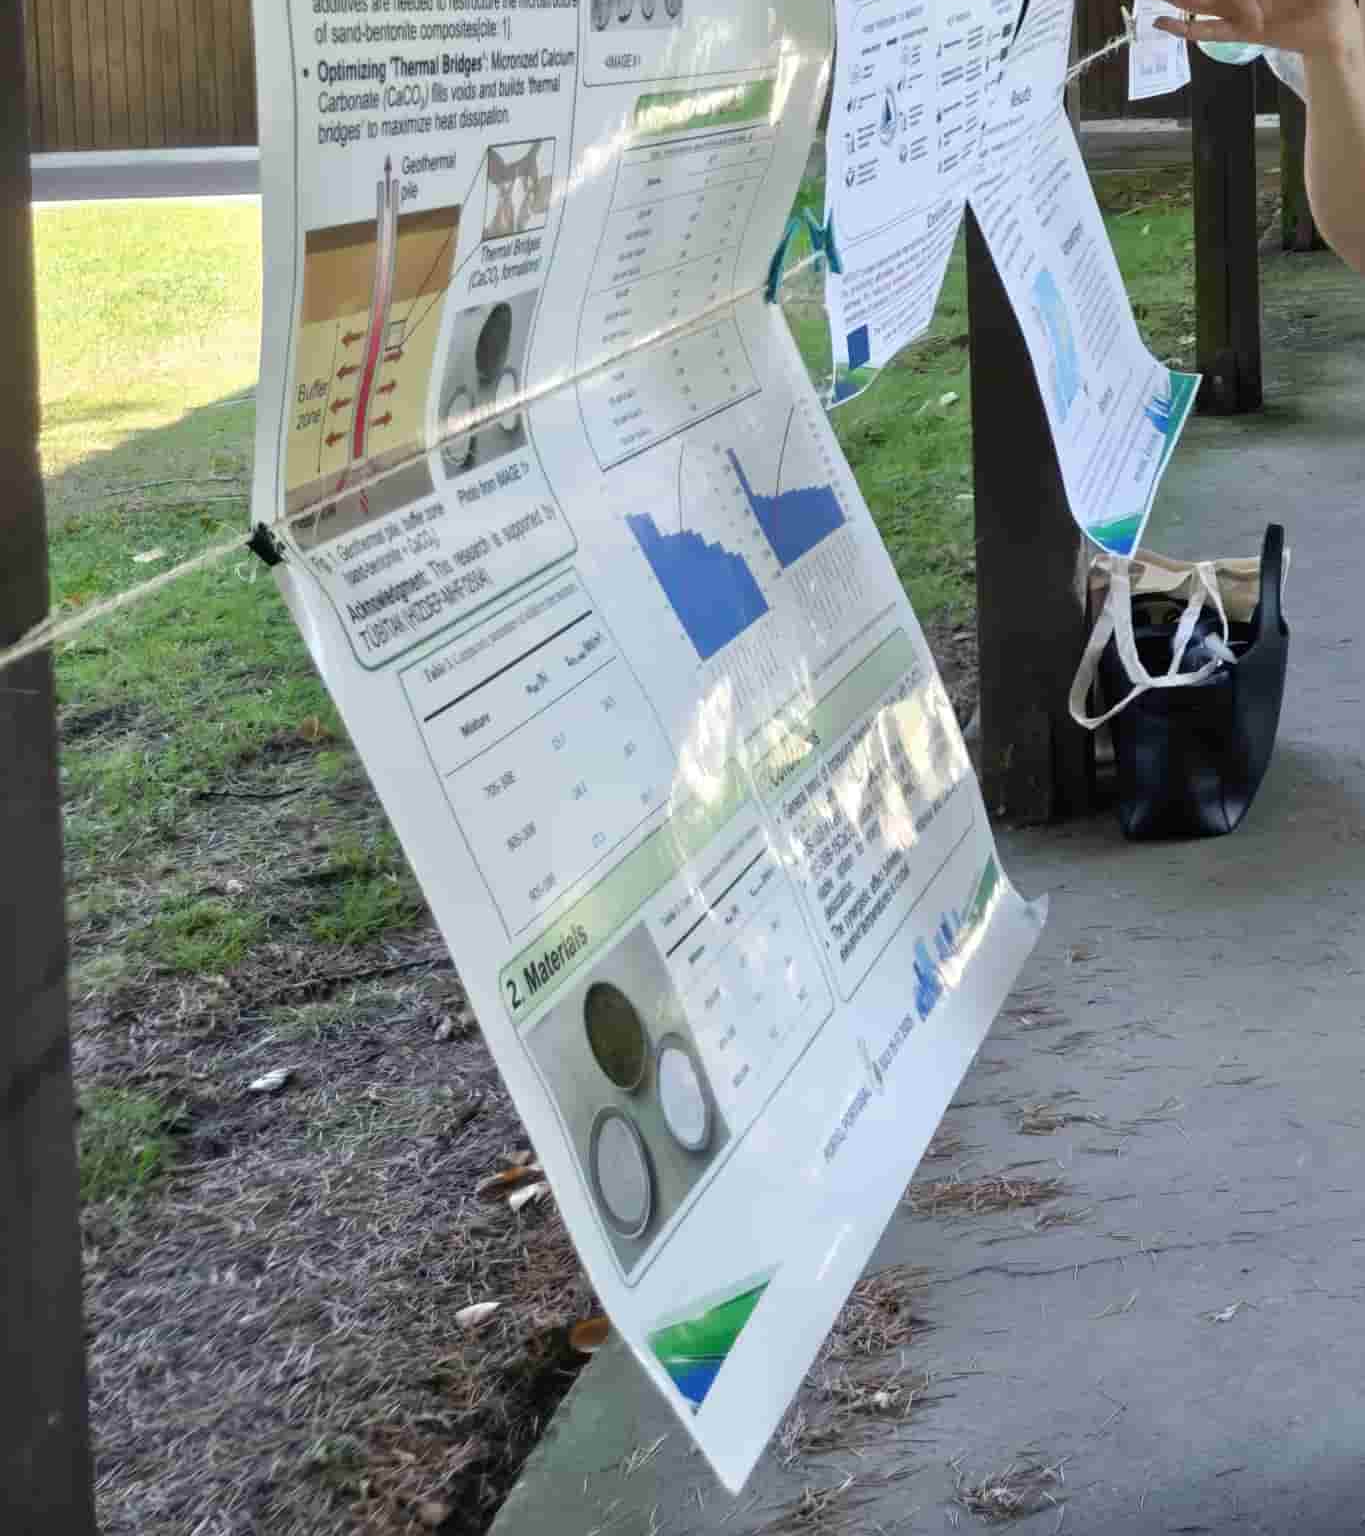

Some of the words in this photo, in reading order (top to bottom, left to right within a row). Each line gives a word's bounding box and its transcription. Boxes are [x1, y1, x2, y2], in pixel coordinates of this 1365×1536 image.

[314, 19, 328, 46] of
[330, 18, 417, 46] sand-bentonite
[317, 58, 387, 88] Optimizing
[318, 89, 380, 115] Carbonate
[366, 120, 379, 140] to
[400, 150, 457, 176] Geothermal
[505, 976, 526, 1010] 2.
[522, 922, 590, 997] Materials
